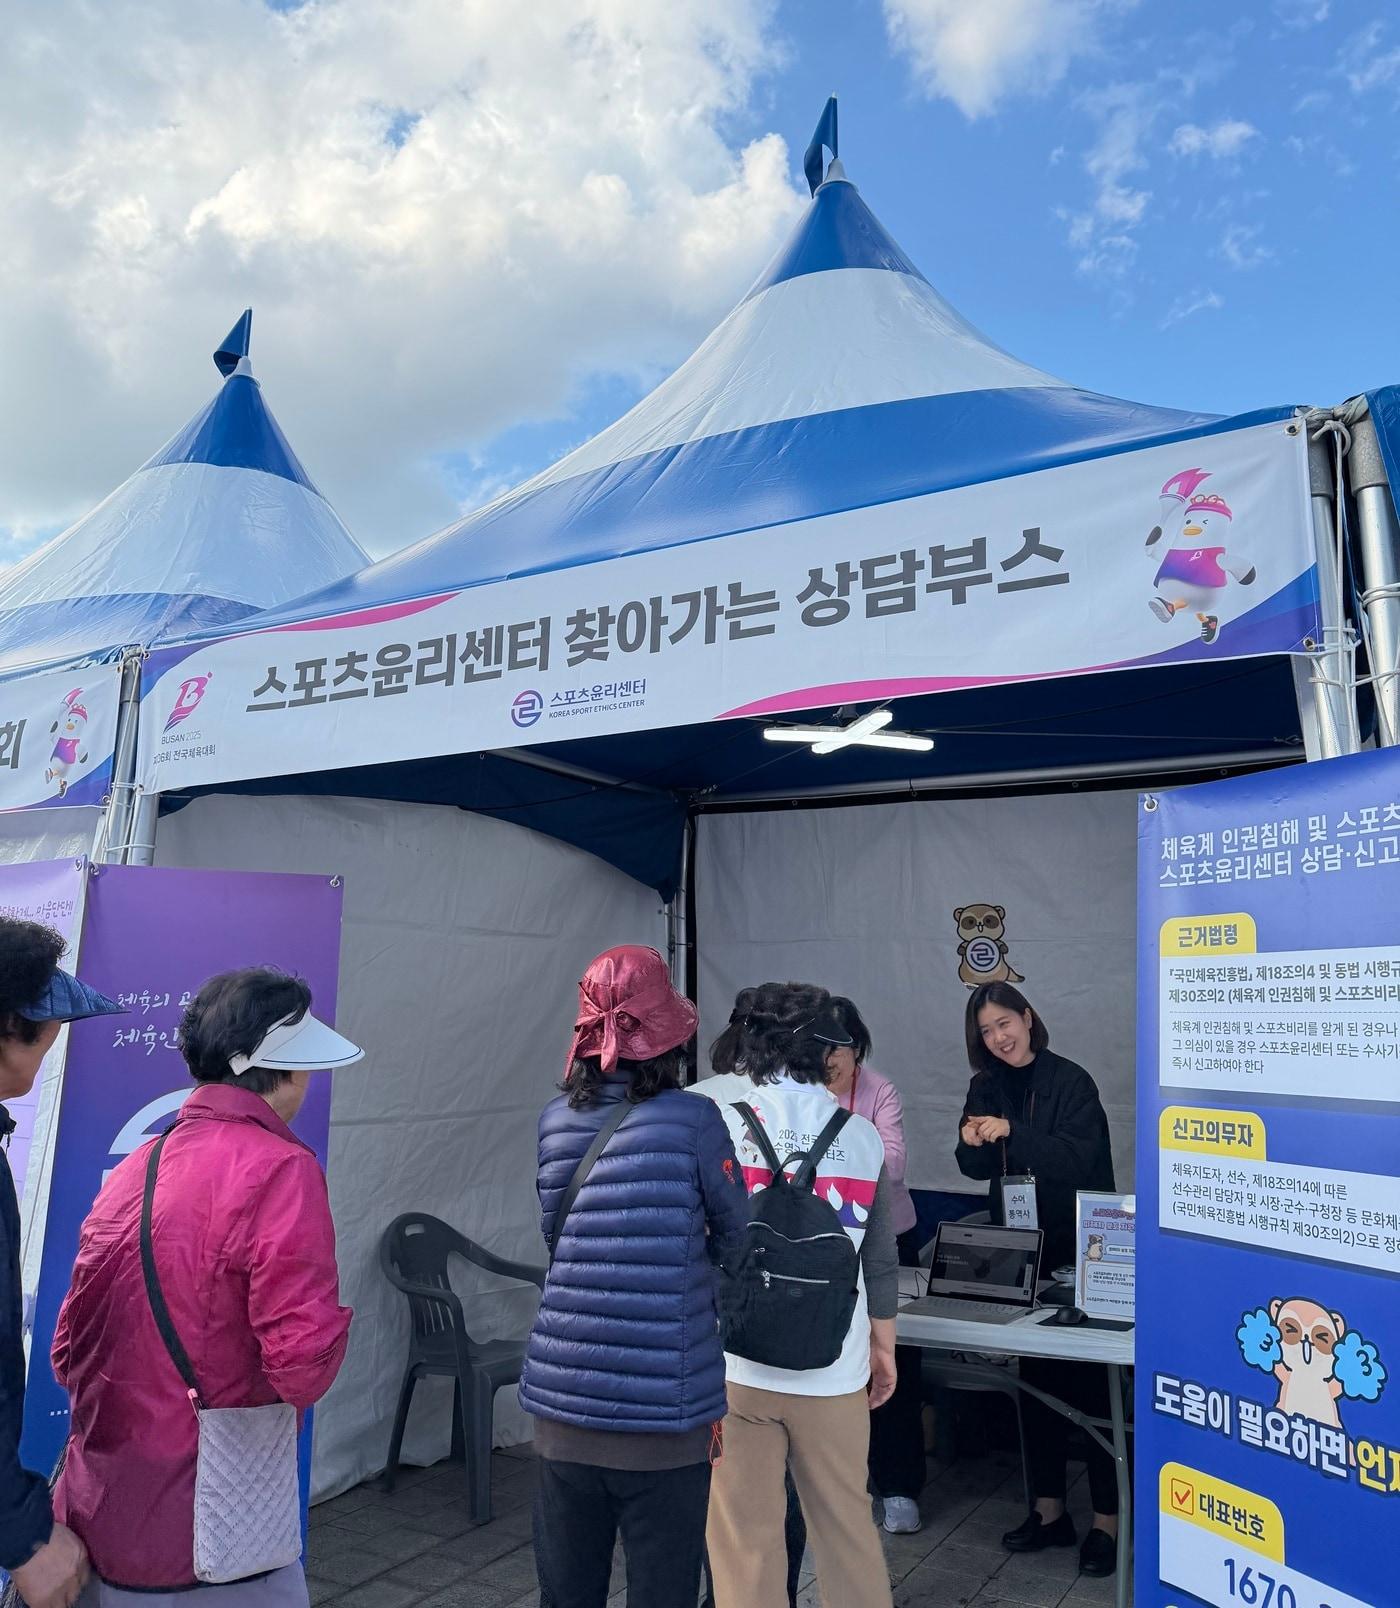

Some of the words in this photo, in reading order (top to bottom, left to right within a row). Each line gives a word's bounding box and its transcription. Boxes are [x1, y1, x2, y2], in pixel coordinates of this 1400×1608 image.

[245, 615, 552, 713] 스포츠윤리센터
[565, 581, 781, 668] 찾아가는
[796, 526, 1071, 630] 상담부스
[550, 678, 647, 708] 스포츠윤리센터
[549, 709, 571, 719] KOREA
[571, 706, 593, 716] SPORT
[594, 703, 618, 713] ETHICS
[618, 699, 645, 709] CENTER
[0, 718, 28, 769] 회
[161, 733, 186, 745] BUSAN
[173, 744, 216, 761] 전국체육대회
[1161, 832, 1214, 861] 체육계
[1221, 819, 1299, 854] 인권침해
[1308, 815, 1328, 843] 및
[1336, 802, 1400, 838] 스포츠
[1159, 850, 1292, 888] 스포츠윤리센터
[1178, 923, 1238, 948] 근거법령
[1256, 964, 1316, 982] 제18조의4
[1318, 963, 1331, 980] 및
[1334, 961, 1360, 979] 동법
[117, 989, 170, 1015] 체육의
[1169, 988, 1225, 1004] 제30조의2
[1228, 987, 1266, 1005] (체육계
[1268, 985, 1316, 1003] 인권침해
[1319, 985, 1331, 1002] 및
[1335, 984, 1400, 1002] 스포츠비리
[1171, 1020, 1201, 1034] 체육계
[1203, 1020, 1242, 1036] 인권침해
[1243, 1020, 1254, 1036] 및
[1256, 1021, 1319, 1037] 스포츠비리를
[1321, 1021, 1345, 1037] 알게
[1346, 1021, 1359, 1037] 된
[1362, 1021, 1399, 1038] 경우나
[1172, 1039, 1183, 1051] 그
[1185, 1039, 1213, 1054] 의심이
[1215, 1039, 1235, 1055] 있을
[1237, 1040, 1257, 1055] 경우
[1259, 1041, 1334, 1057] 스포츠윤리센터
[1336, 1042, 1360, 1058] 또는
[1362, 1042, 1400, 1060] 수사기
[1171, 1056, 1192, 1071] 즉시
[1194, 1057, 1242, 1073] 신고하여야
[1244, 1058, 1265, 1074] 한다
[1172, 1117, 1254, 1148] 신고의무자
[1171, 1162, 1225, 1185] 체육지도자,
[1227, 1170, 1250, 1188] 선수,
[1252, 1173, 1322, 1198] 제18조의14에
[1324, 1182, 1349, 1201] 따른
[1008, 1208, 1031, 1220] 통역사
[1171, 1181, 1213, 1200] 선수관리
[1214, 1187, 1244, 1206] 담당자
[1246, 1191, 1257, 1208] 및
[1259, 1193, 1342, 1222] 시장·군수·구청장
[1345, 1207, 1358, 1225] 등
[1361, 1209, 1400, 1232] 문화체
[1248, 1213, 1290, 1236] 시행규칙
[1292, 1220, 1381, 1250] 제30조의2)으로
[1154, 1373, 1231, 1436] 도움이
[1238, 1399, 1348, 1479] 필요하면
[1199, 1492, 1266, 1542] 대표번호
[1223, 1557, 1297, 1608] 1670
